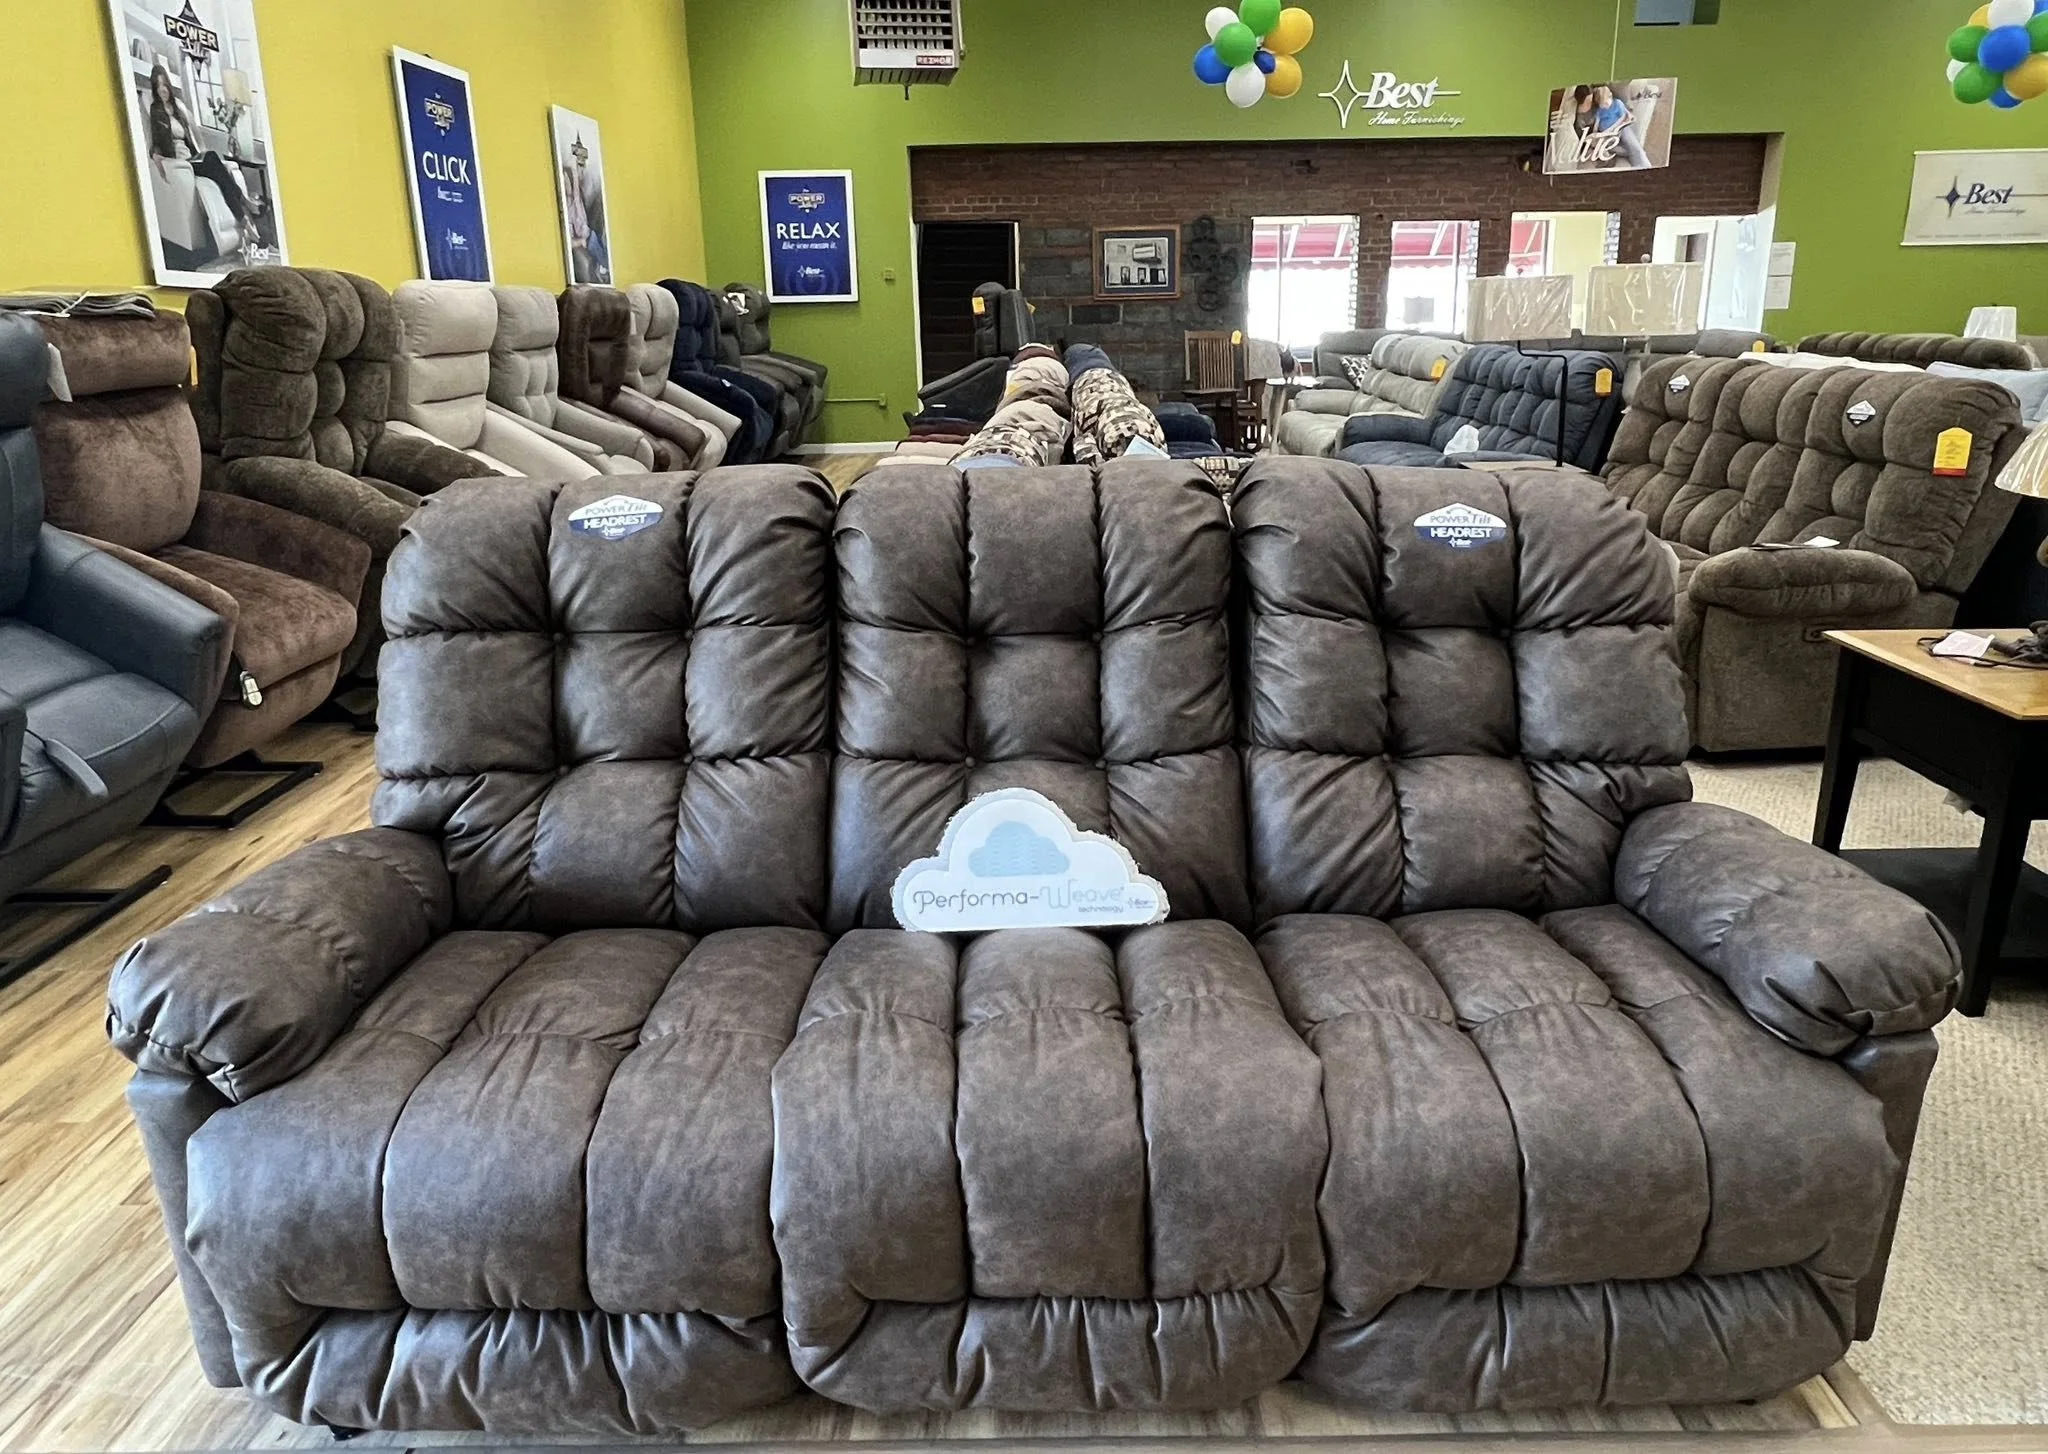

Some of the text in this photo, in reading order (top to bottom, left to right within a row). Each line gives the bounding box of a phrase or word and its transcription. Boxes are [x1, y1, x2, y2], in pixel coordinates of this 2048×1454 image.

[165, 17, 218, 49] POWER
[1361, 71, 1439, 109] Best
[1368, 110, 1466, 128] Home Furnishings
[422, 150, 472, 186] CLICK
[1963, 182, 2014, 205] Best
[776, 222, 841, 240] RELAX
[585, 505, 624, 516] POWER
[1430, 515, 1470, 524] POWER
[583, 514, 648, 530] HEADREST
[1430, 527, 1492, 538] HEADREST
[1078, 904, 1124, 914] technology
